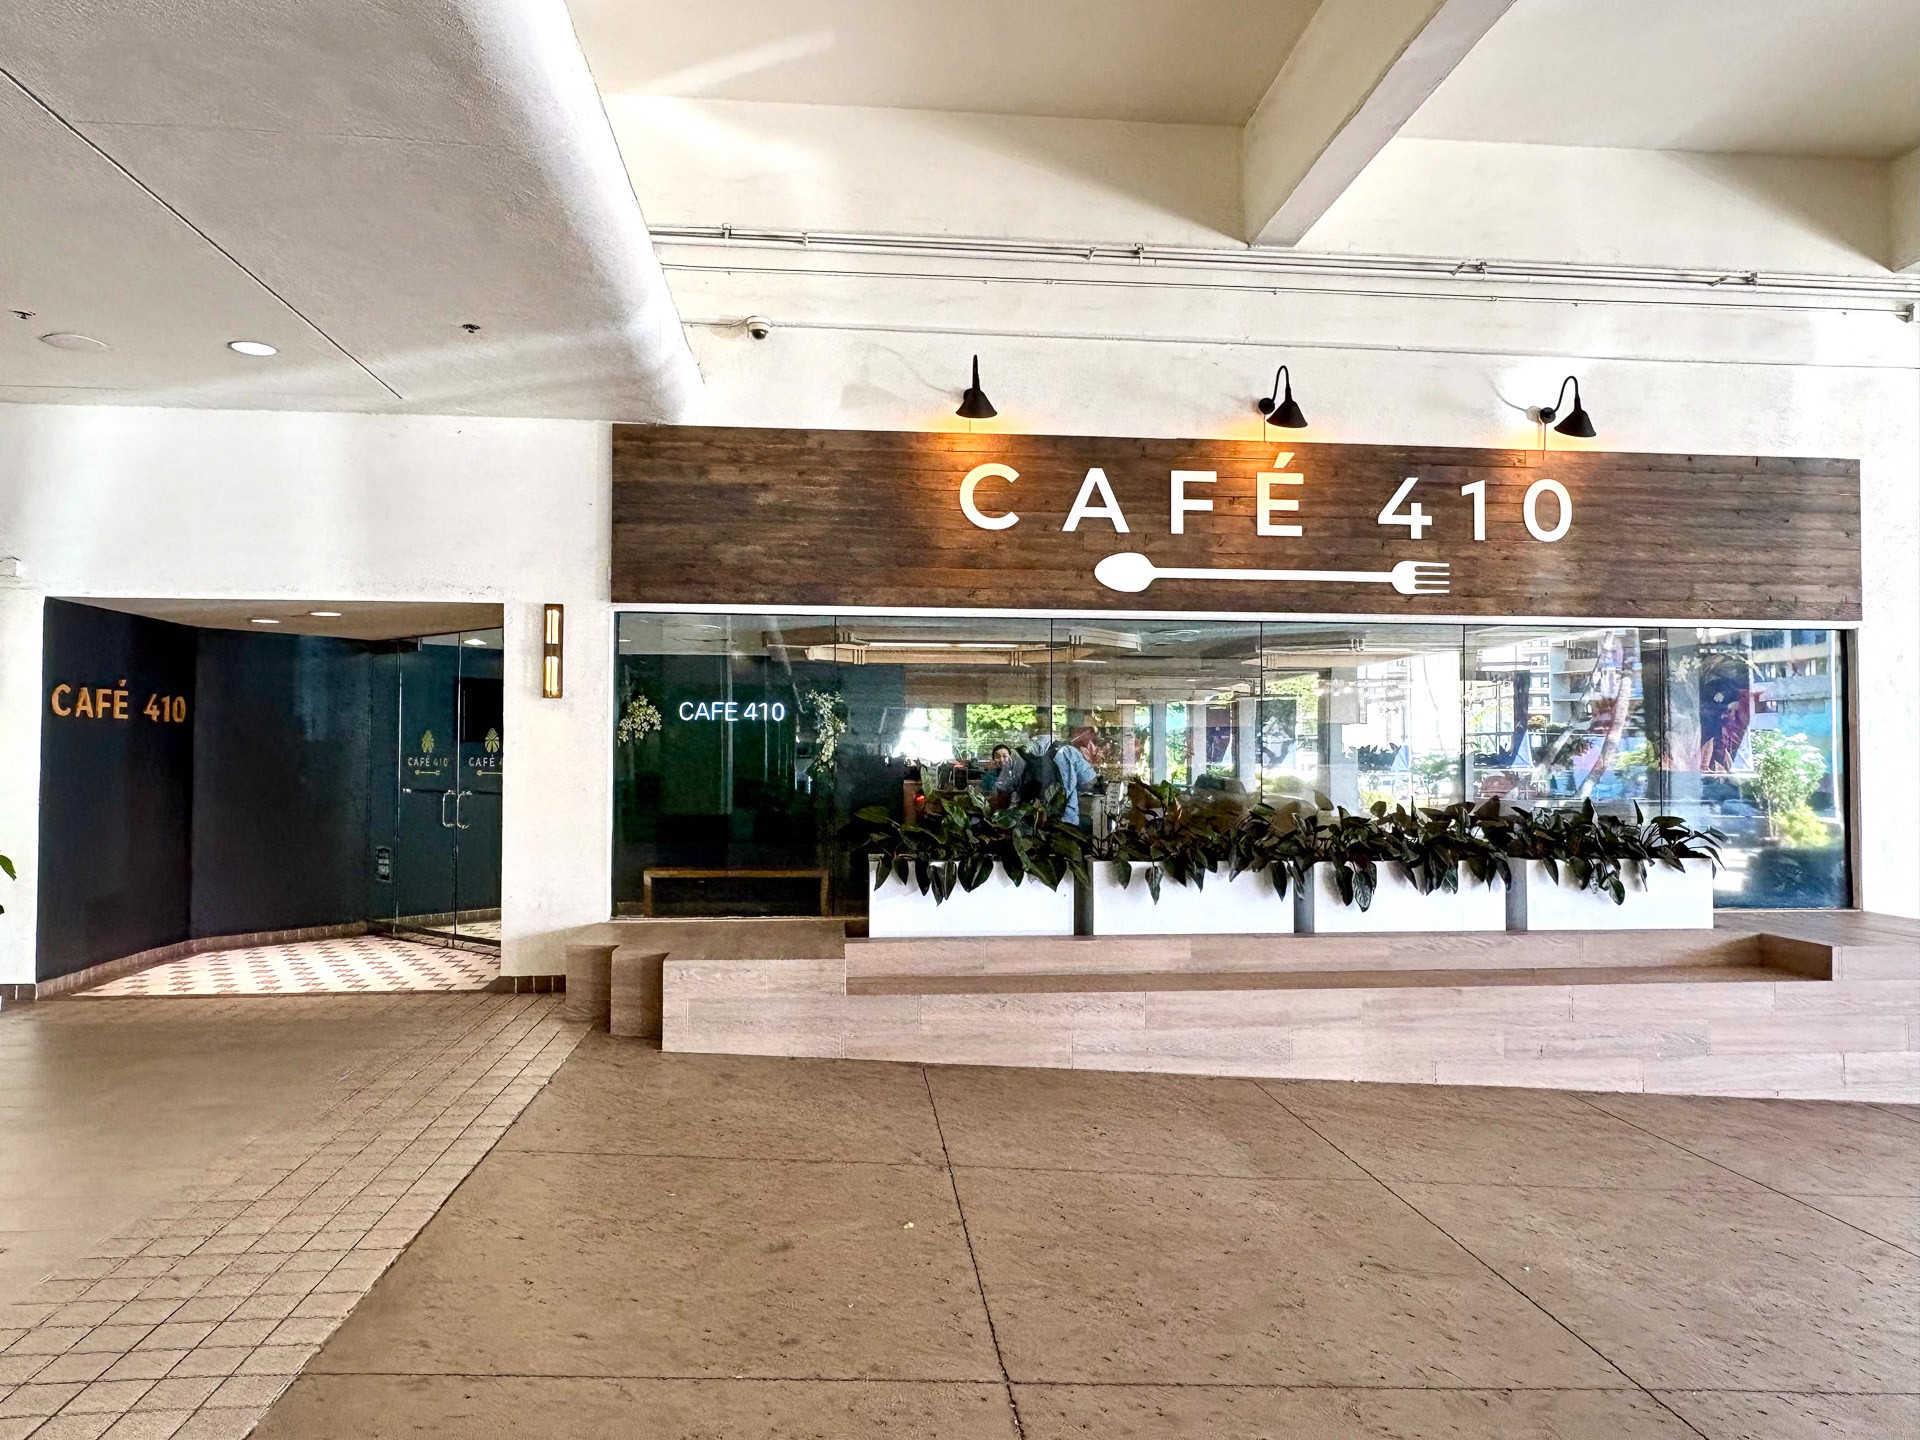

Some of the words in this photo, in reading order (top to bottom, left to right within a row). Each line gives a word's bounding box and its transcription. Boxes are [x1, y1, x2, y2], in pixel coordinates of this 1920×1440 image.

[959, 452, 1304, 537] CAFÉ
[1377, 477, 1573, 542] 410
[51, 679, 129, 719] CAFÉ
[143, 693, 187, 722] 410
[679, 701, 739, 722] CAFE
[743, 702, 785, 722] 410
[468, 754, 496, 767] CAFÉ
